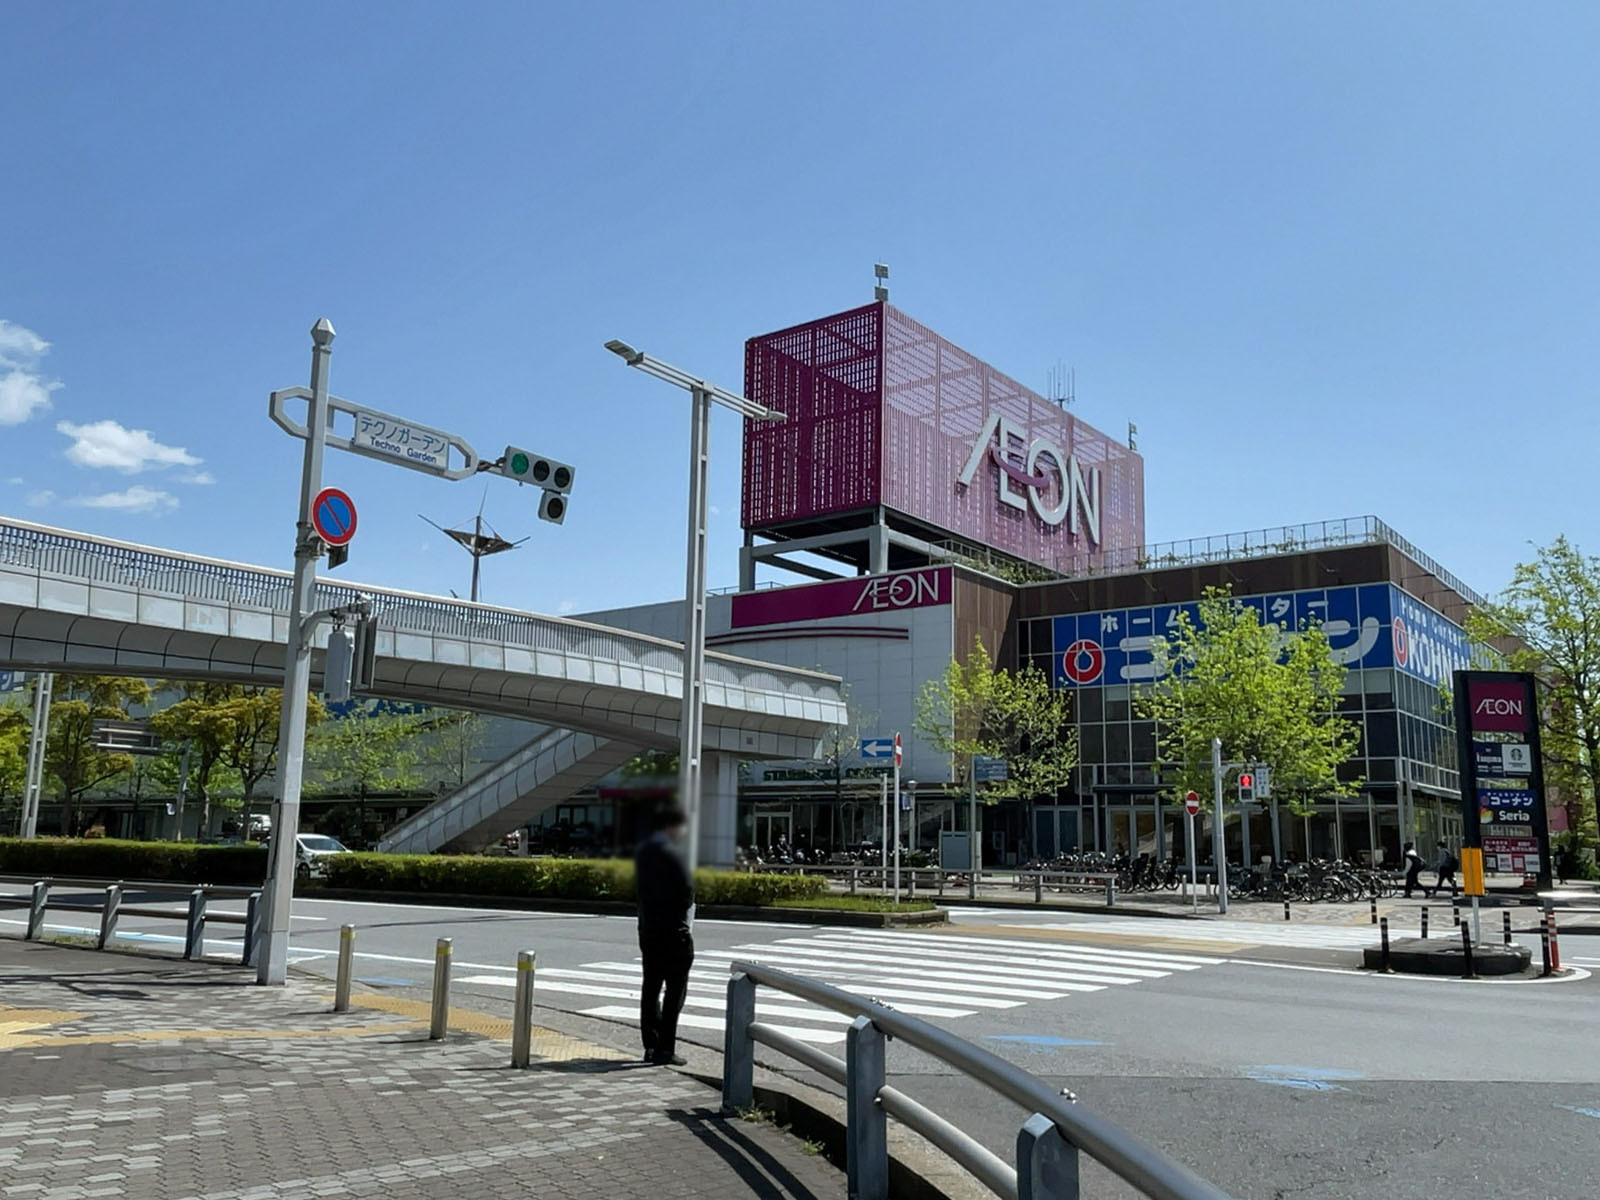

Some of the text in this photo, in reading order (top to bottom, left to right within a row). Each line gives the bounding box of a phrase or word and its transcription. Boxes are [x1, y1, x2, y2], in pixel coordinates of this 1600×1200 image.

[360, 416, 446, 454] テクノガーデン
[369, 435, 437, 464] Techno Garden
[1490, 795, 1533, 806] コーナン
[1498, 809, 1531, 822] Seria
